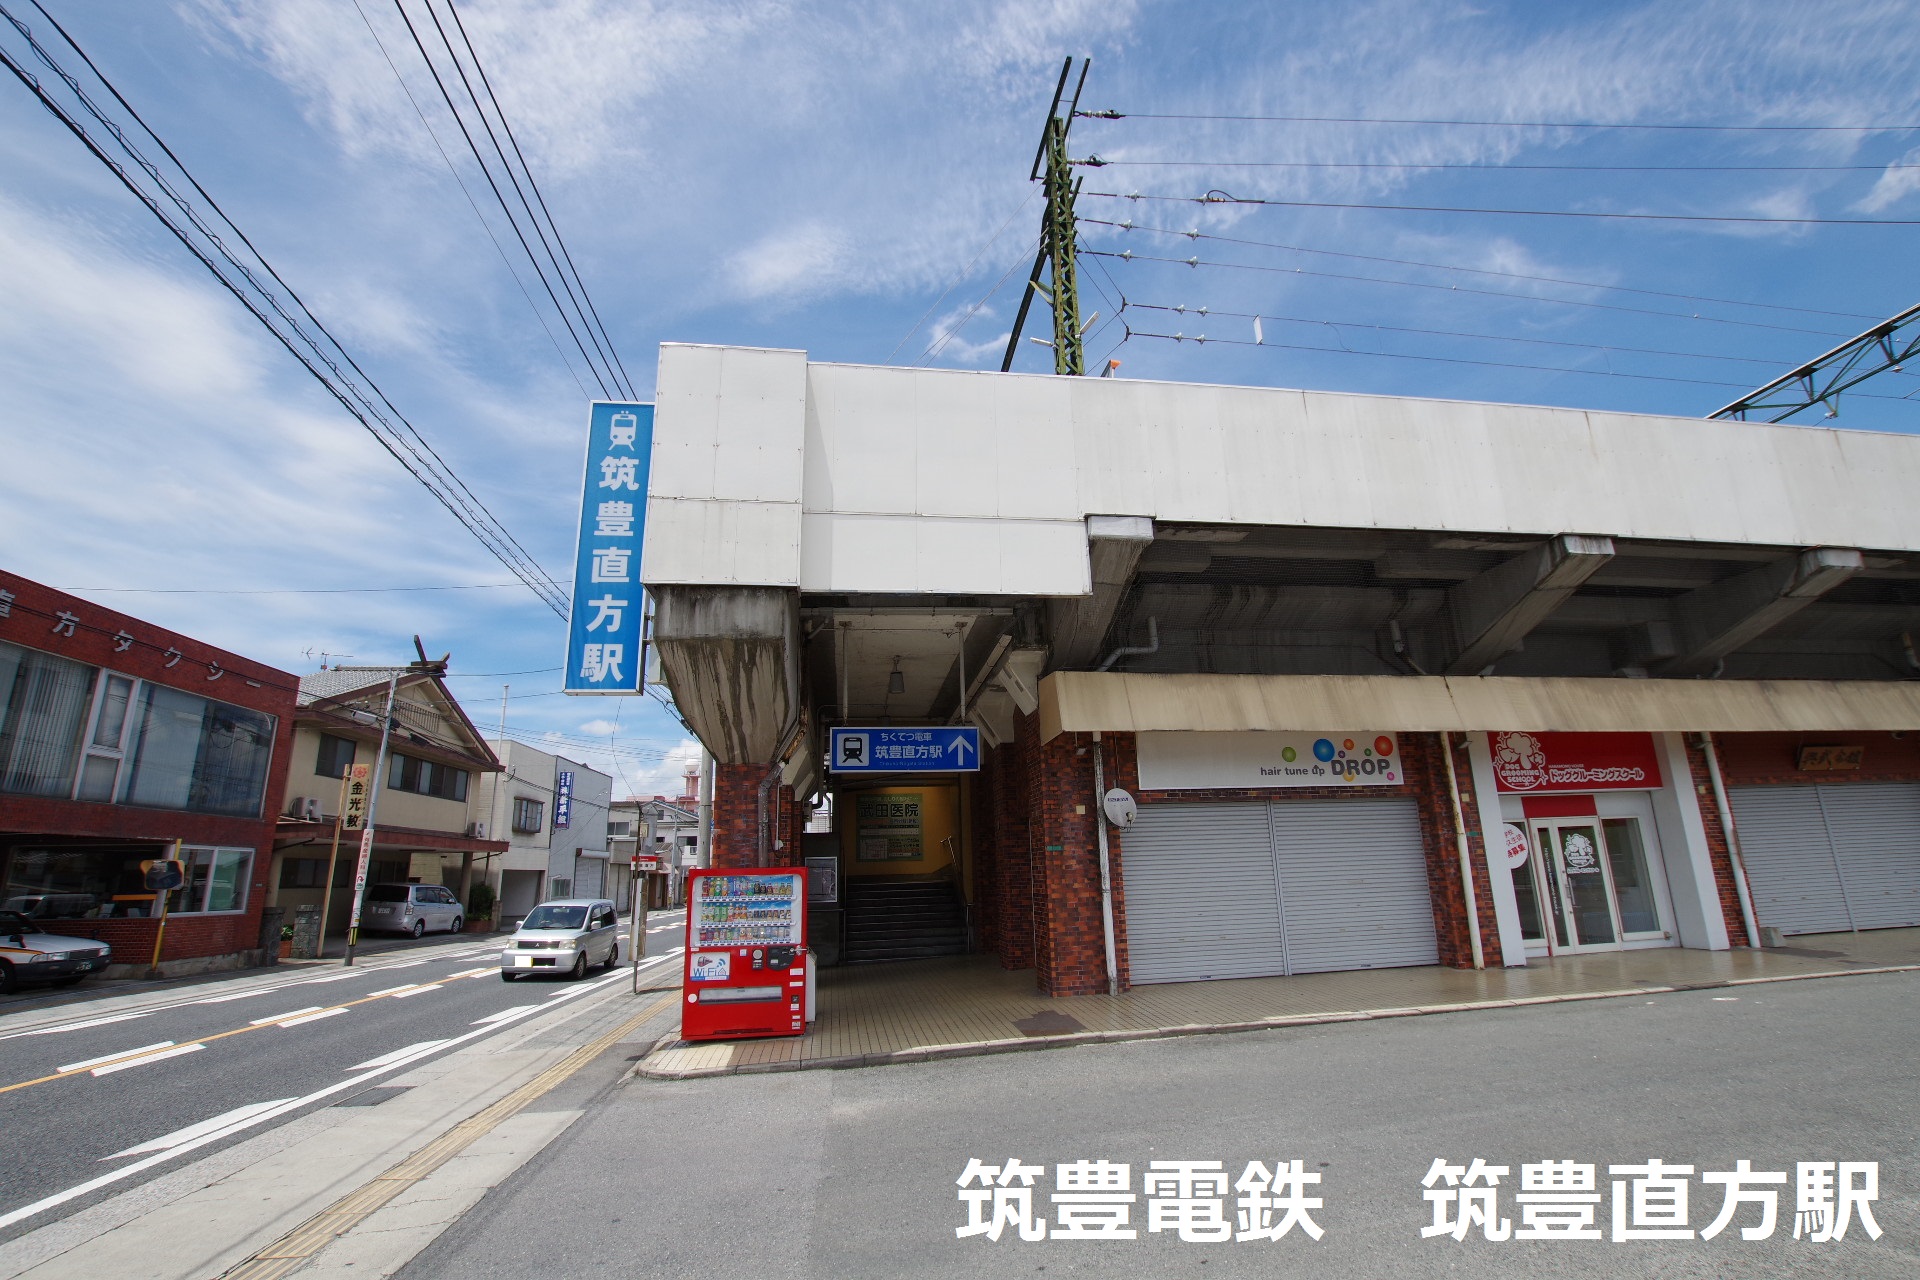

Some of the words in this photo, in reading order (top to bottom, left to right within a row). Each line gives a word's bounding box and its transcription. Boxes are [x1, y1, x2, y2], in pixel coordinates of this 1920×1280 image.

[580, 455, 640, 683] 筑豊直方駅
[880, 732, 933, 742] ちくてつ電車
[874, 745, 943, 759] 筑豊直方駅
[1260, 766, 1282, 776] hair
[1285, 767, 1309, 776] tune
[1312, 765, 1326, 777] up
[1331, 758, 1391, 776] DROP
[1501, 769, 1540, 777] GROOMING
[1549, 767, 1645, 784] ドッググルーミングスクール
[346, 781, 363, 828] 金光教
[859, 803, 919, 817] 武田医院
